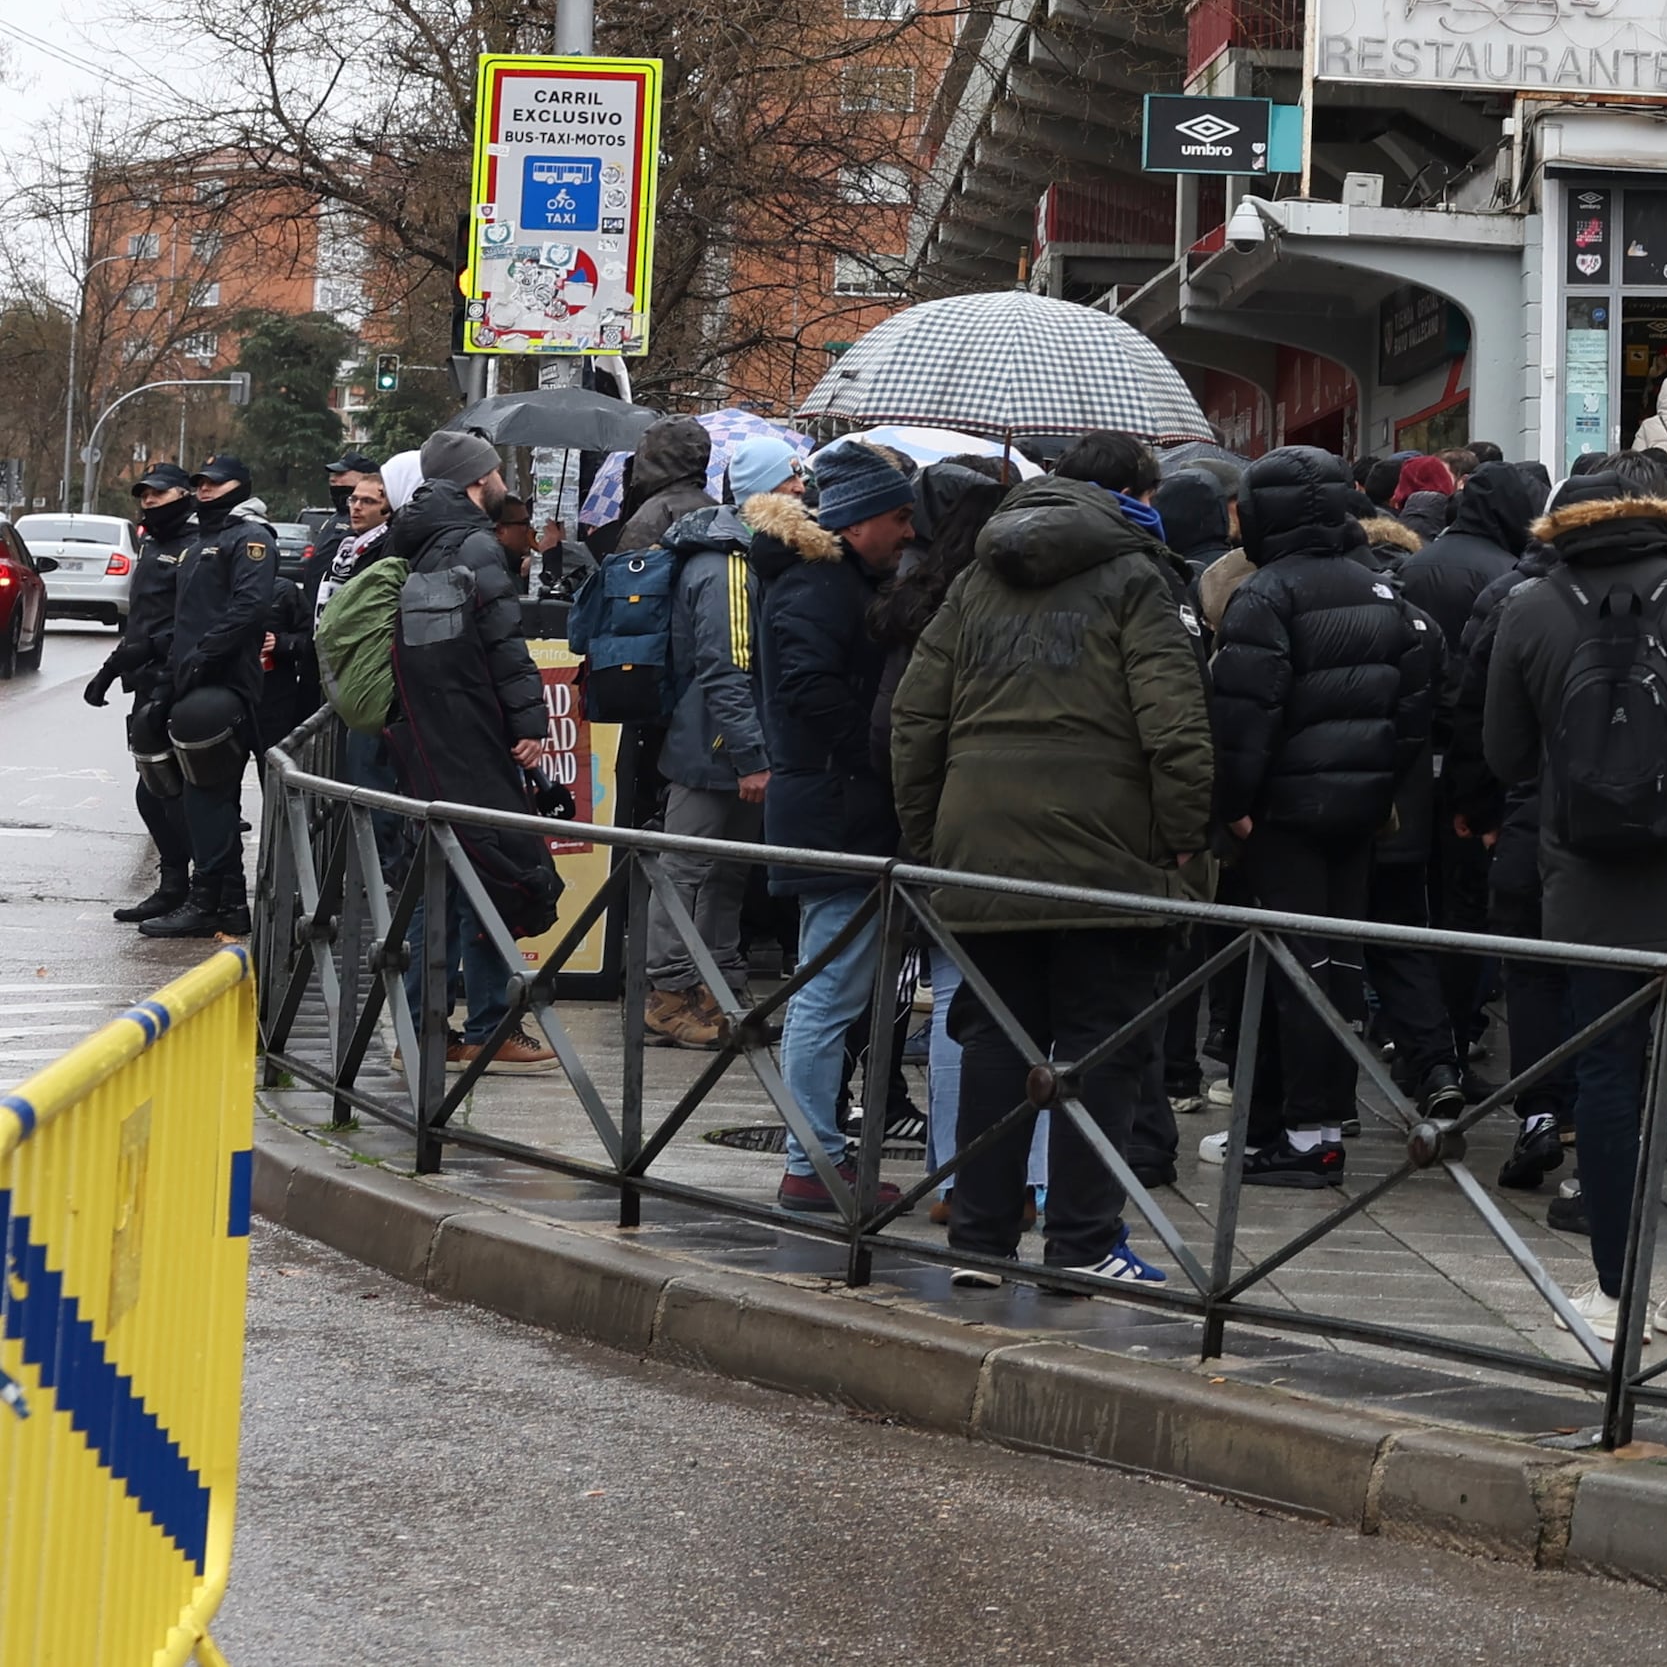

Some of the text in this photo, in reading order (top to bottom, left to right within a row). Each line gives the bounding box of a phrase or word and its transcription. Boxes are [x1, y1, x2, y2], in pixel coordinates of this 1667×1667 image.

[534, 90, 603, 105] CARRIL
[513, 109, 622, 125] EXCLUSIVO
[505, 131, 626, 146] BUS-TAXI-MOTOS
[1181, 142, 1234, 158] umbro
[545, 213, 577, 224] TAXI
